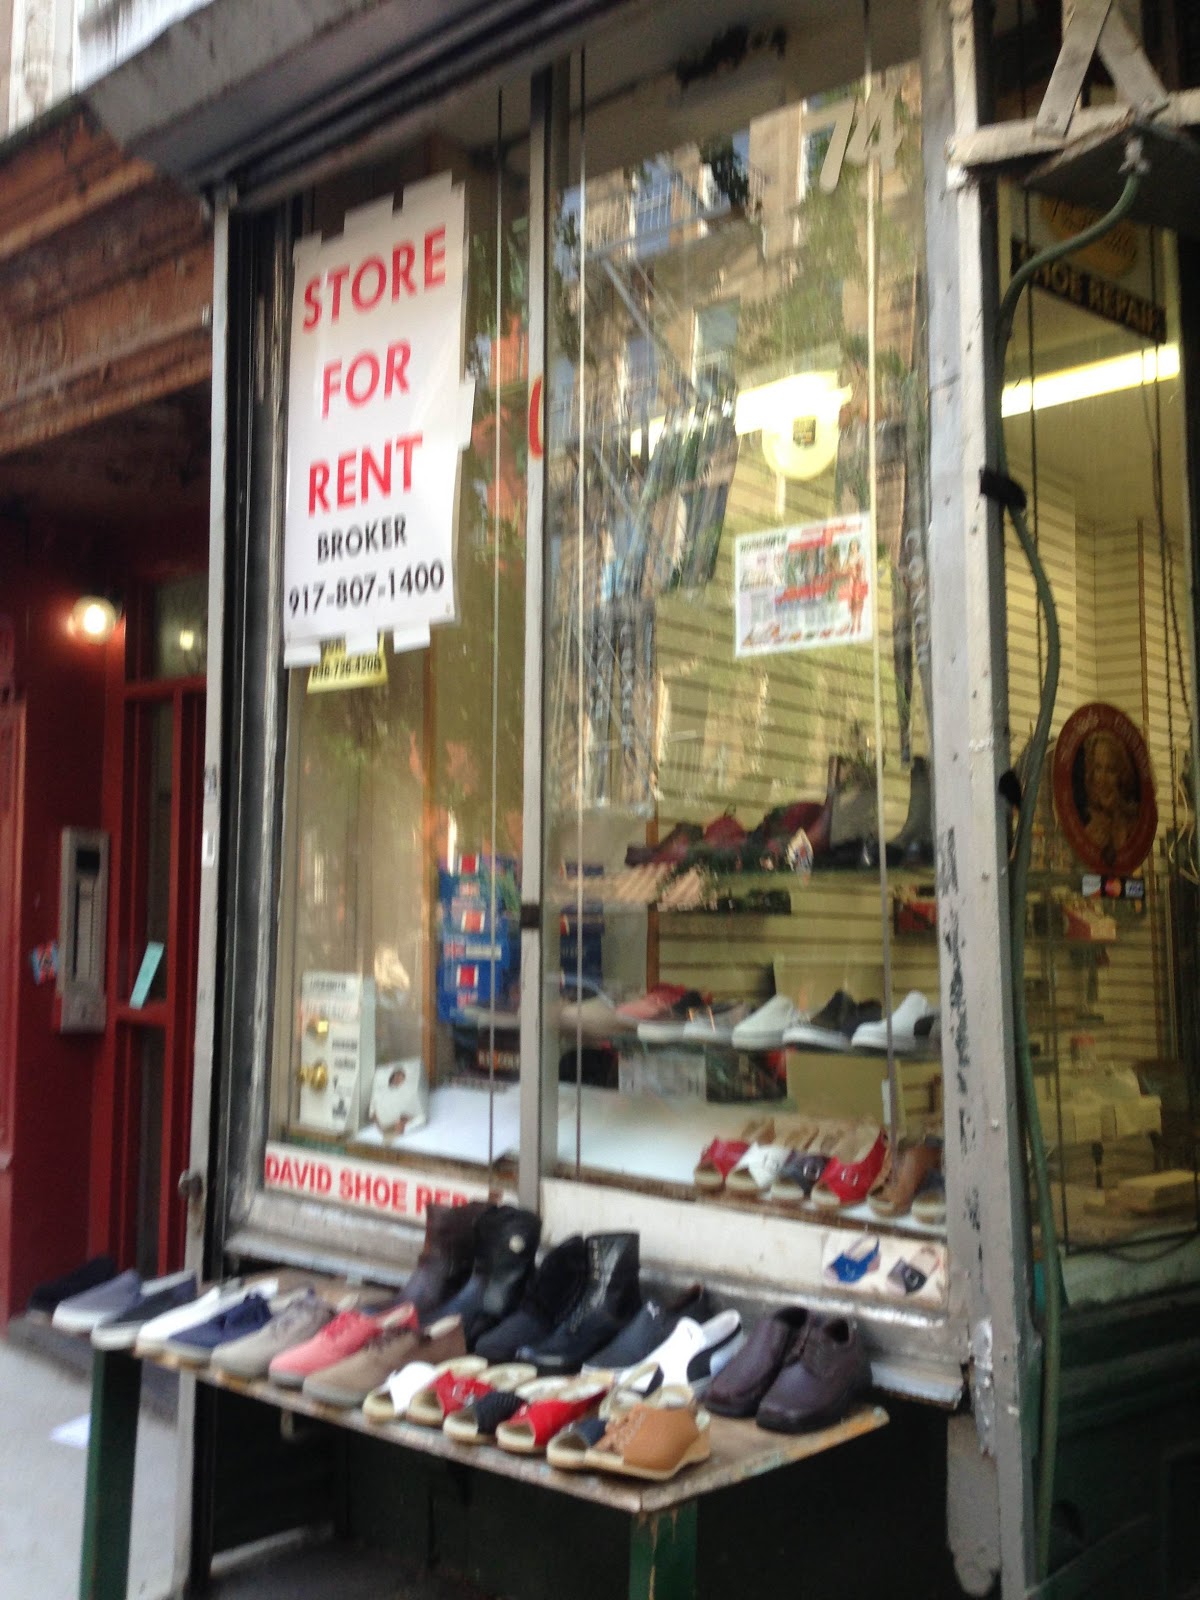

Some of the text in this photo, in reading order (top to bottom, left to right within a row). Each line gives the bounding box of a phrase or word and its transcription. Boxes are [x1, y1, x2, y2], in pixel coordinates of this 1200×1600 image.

[302, 224, 447, 334] STORE
[322, 337, 412, 420] FOR
[308, 431, 424, 519] RENT
[317, 513, 408, 564] BROKER
[288, 560, 446, 619] 917-807-1400
[265, 1154, 333, 1196] DAVID
[339, 1168, 408, 1214] SHOE
